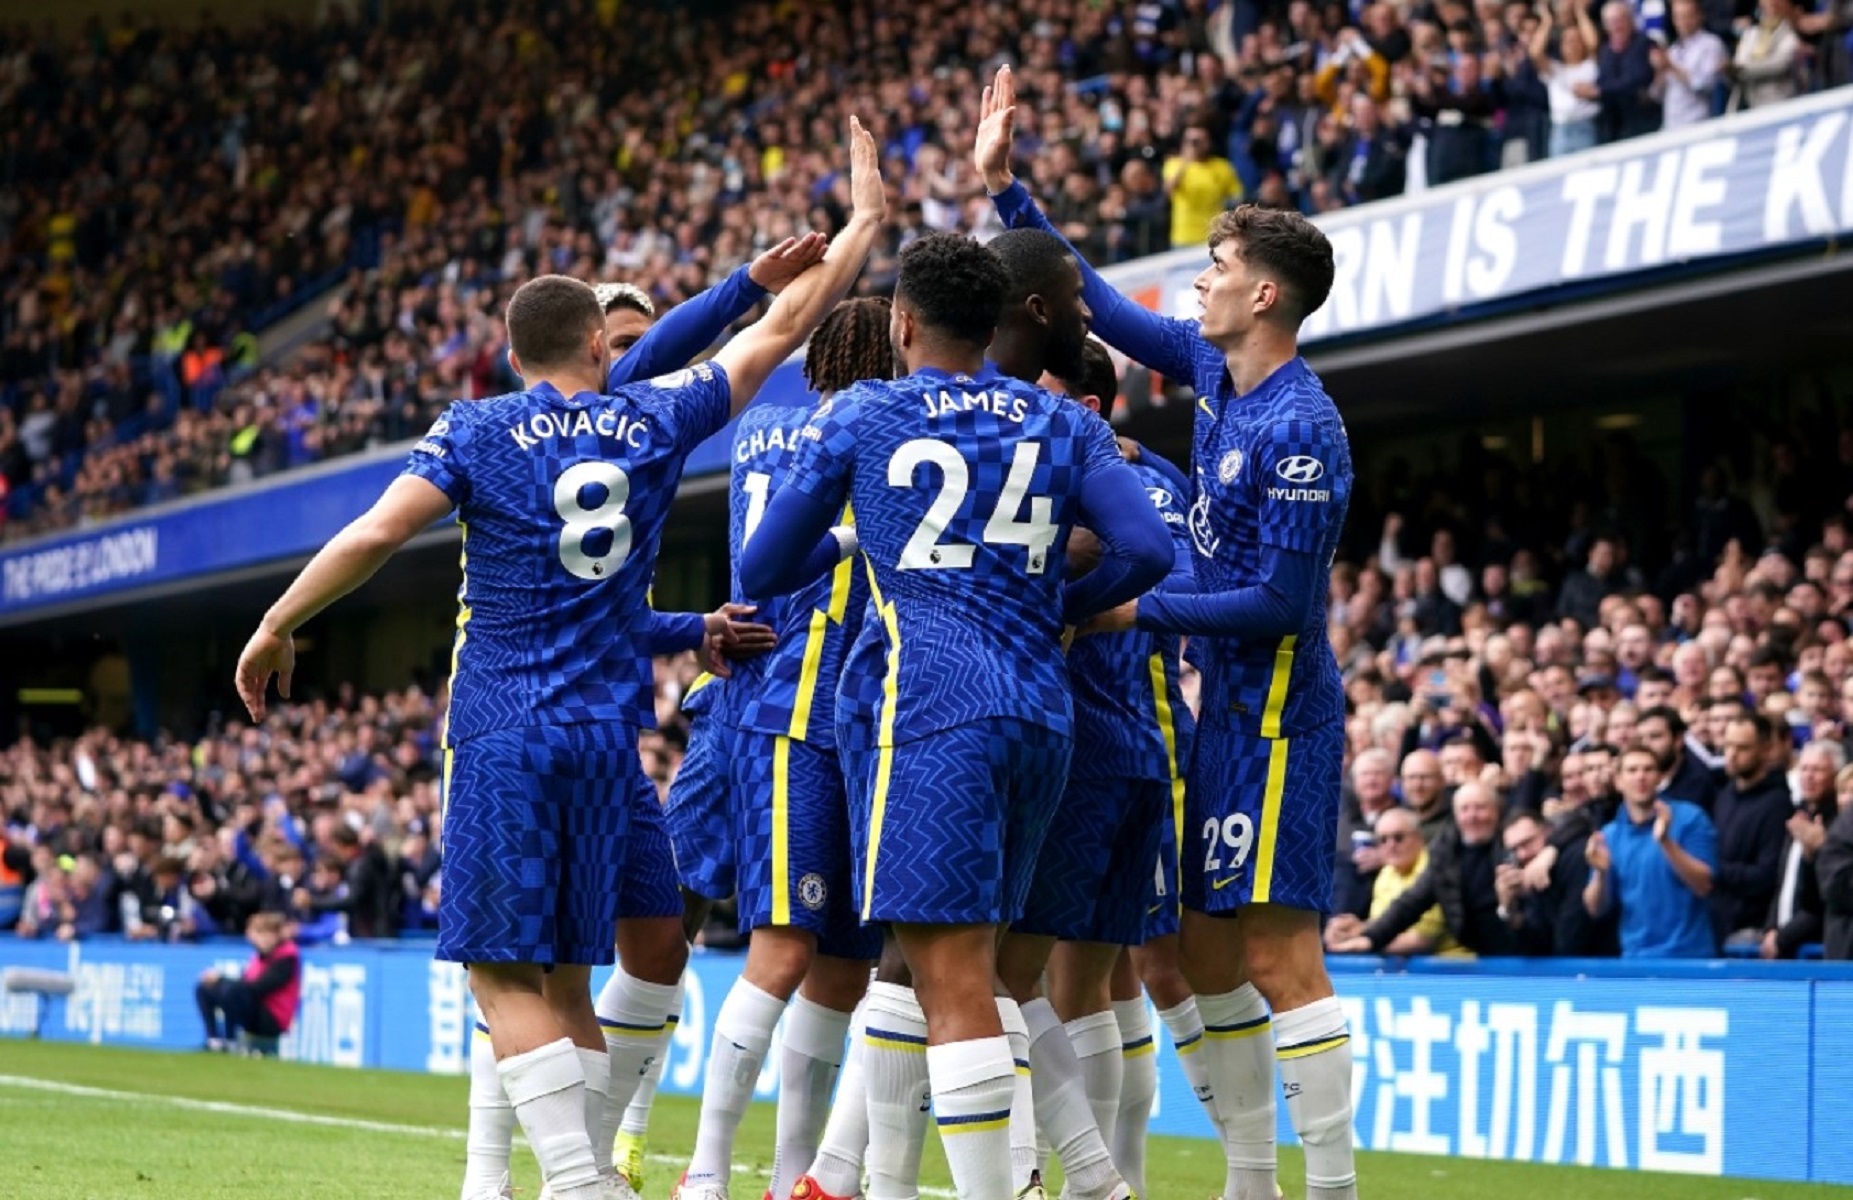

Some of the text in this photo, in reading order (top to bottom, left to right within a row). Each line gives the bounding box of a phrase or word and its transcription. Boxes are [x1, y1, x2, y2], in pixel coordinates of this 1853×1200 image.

[1443, 185, 1525, 303] IS
[1560, 138, 1737, 278] THE
[509, 409, 648, 451] KOVAČIĆ
[922, 390, 1029, 423] JAMES
[553, 461, 633, 580] 8
[888, 438, 1059, 575] 24
[1267, 488, 1330, 502] HYUNDAI
[1203, 812, 1254, 873] 29
